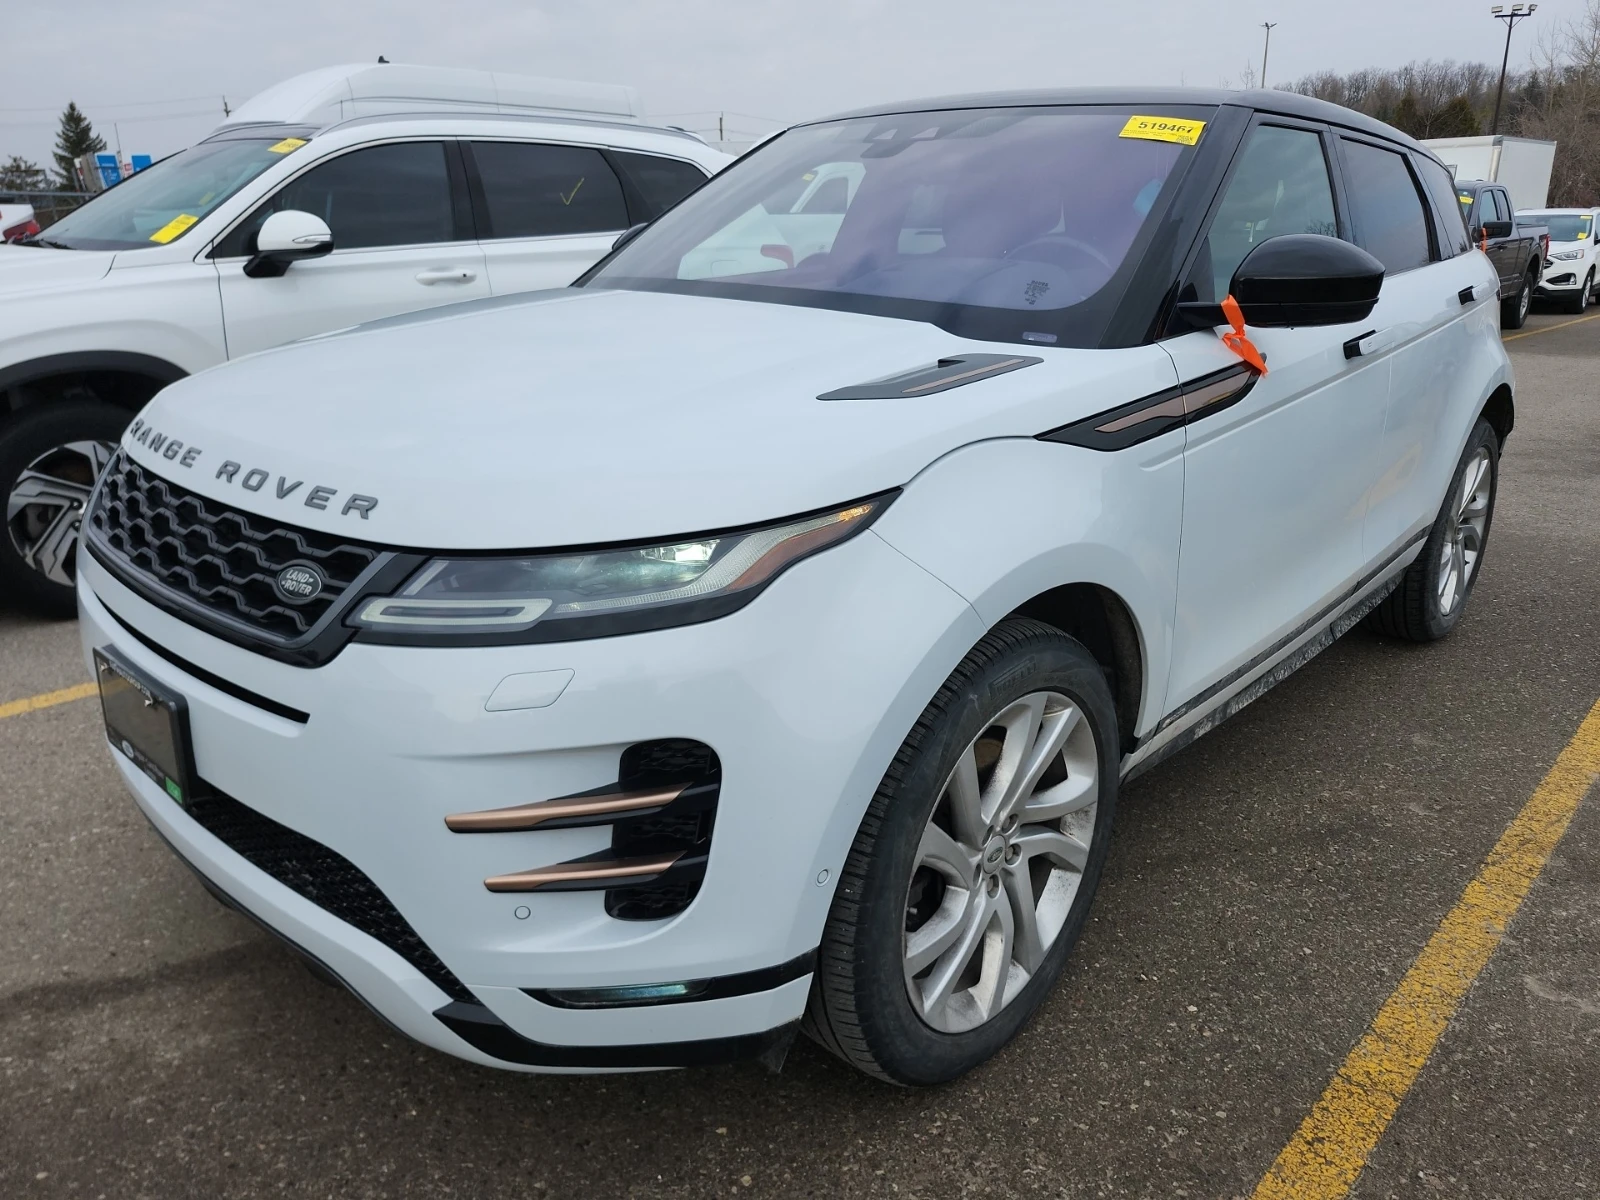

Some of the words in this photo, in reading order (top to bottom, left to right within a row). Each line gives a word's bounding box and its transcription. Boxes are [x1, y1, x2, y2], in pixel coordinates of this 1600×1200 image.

[1138, 121, 1194, 133] 519467
[130, 418, 203, 468] RANGE
[215, 460, 379, 520] ROVER
[286, 569, 310, 583] LAND
[283, 579, 313, 595] ROVER
